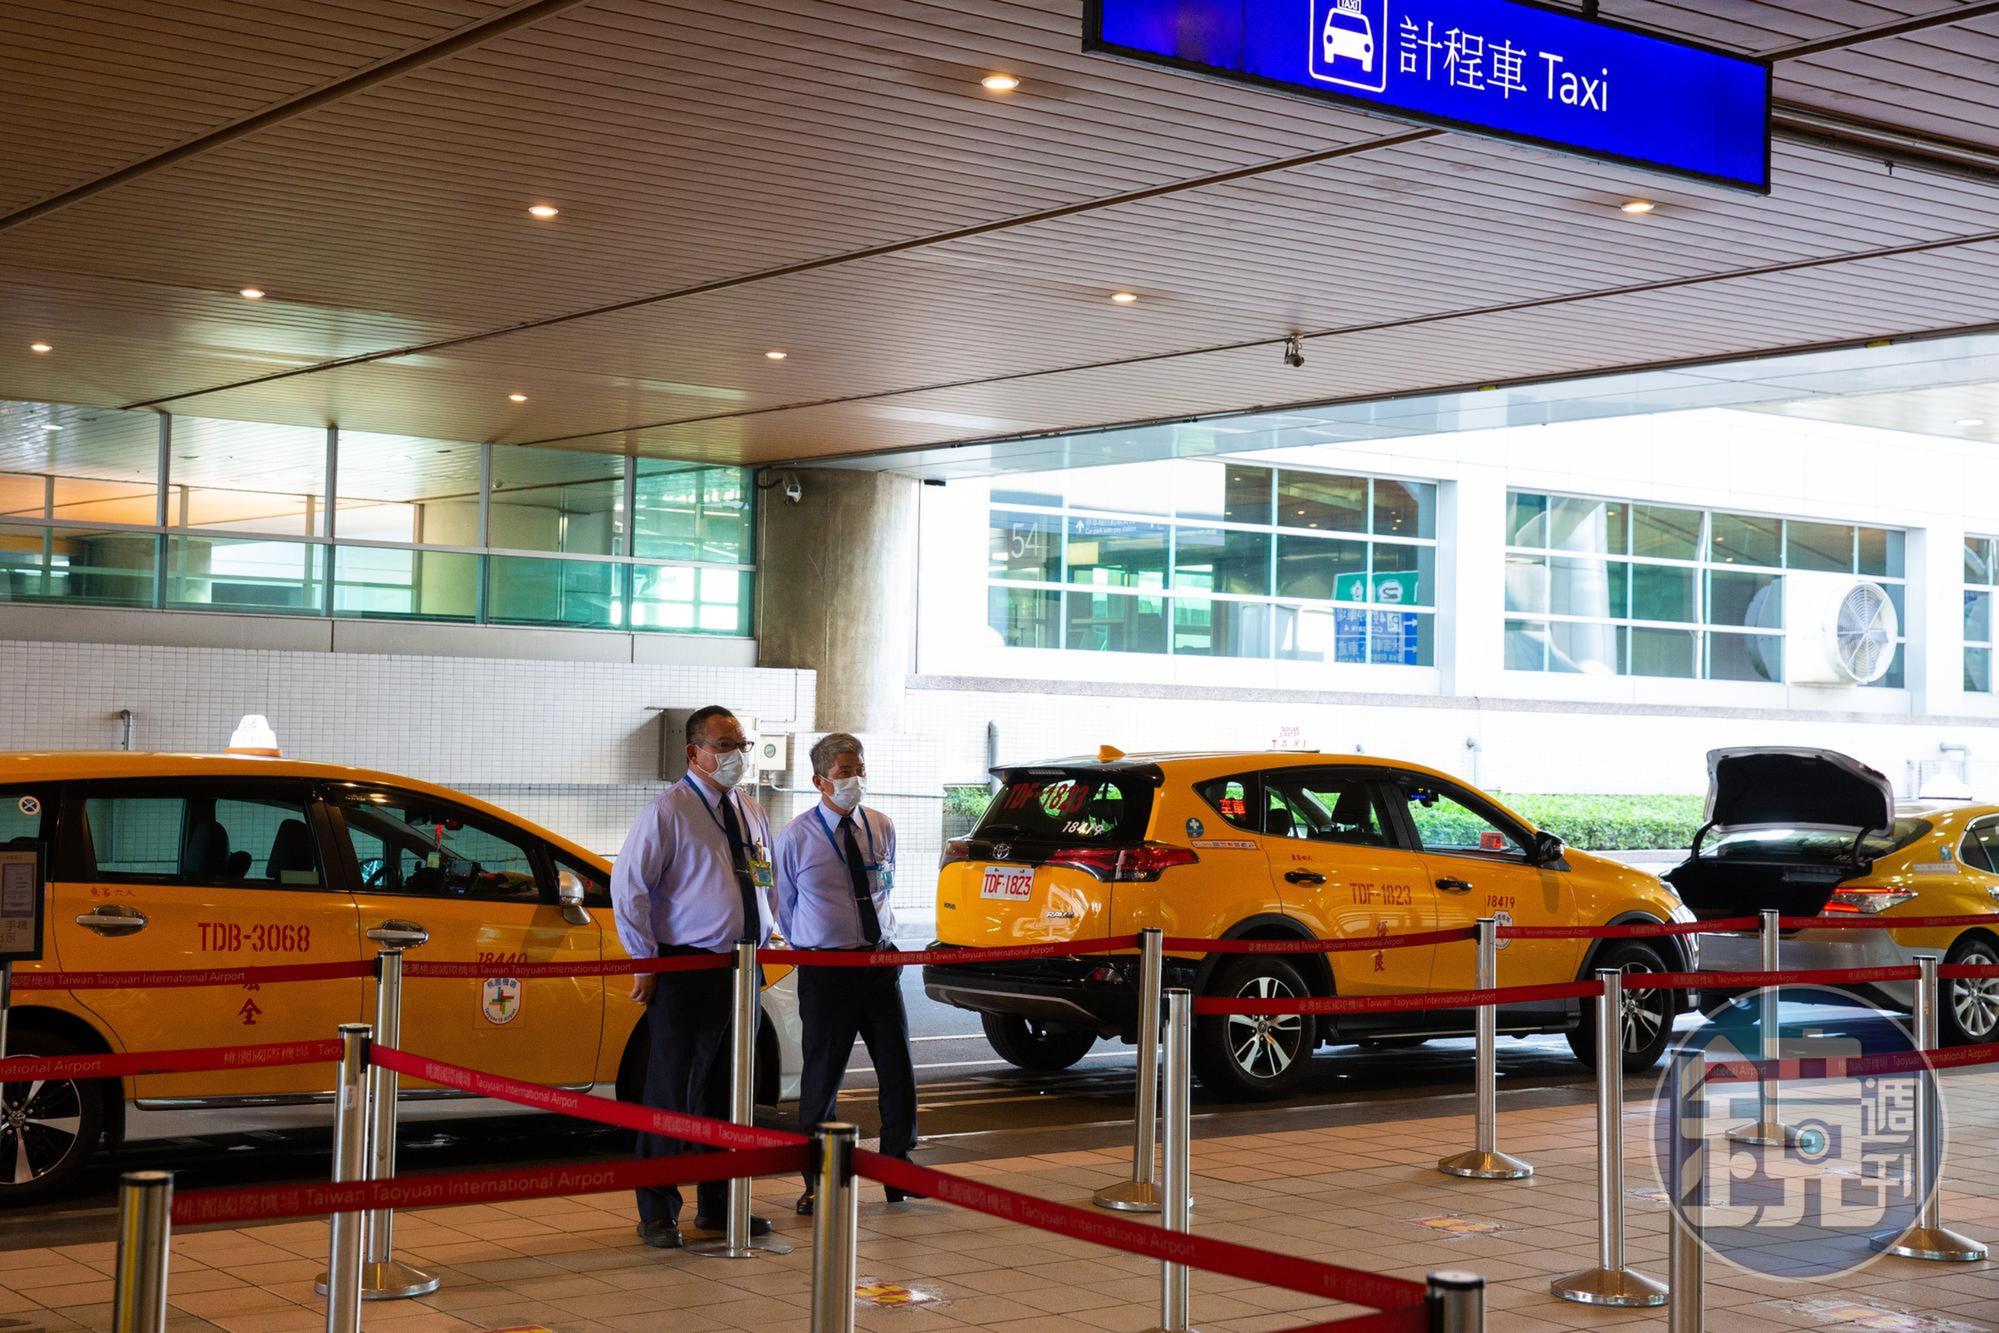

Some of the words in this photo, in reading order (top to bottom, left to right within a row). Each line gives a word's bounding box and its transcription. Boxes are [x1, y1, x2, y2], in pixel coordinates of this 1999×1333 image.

[1400, 15, 1527, 99] 計程車
[1539, 51, 1608, 112] Taxi
[1350, 883, 1412, 905] TDF-1823
[1487, 895, 1515, 909] 18419
[198, 922, 311, 952] TDB-3068
[932, 952, 957, 962] Taiwan
[958, 950, 985, 962] Taoyuan
[986, 947, 1029, 959] International
[1031, 945, 1054, 957] Airport
[58, 973, 94, 985] Taiwan
[97, 973, 140, 987] Taoyuan
[142, 969, 208, 984] International
[209, 970, 245, 983] Airport
[480, 964, 509, 974] Taiwan
[512, 964, 546, 978] Taoyuan
[548, 963, 600, 974] International
[602, 963, 631, 976] Airport
[1366, 998, 1391, 1008] Taiwan
[1392, 997, 1423, 1009] Taoyuan
[1425, 994, 1471, 1006] International
[1472, 992, 1496, 1005] Airport
[1968, 1048, 1992, 1061] Airport
[53, 1059, 101, 1075] Airport
[475, 1074, 504, 1095] Taoyuan
[551, 1092, 578, 1110] Airport
[305, 1184, 366, 1208] Taiwan
[372, 1181, 443, 1207] Taoyuan
[447, 1173, 554, 1195] International
[557, 1170, 615, 1192] Airport
[1020, 1200, 1067, 1231] Taoyuan
[1070, 1212, 1147, 1248] International
[1150, 1230, 1197, 1259] Airport
